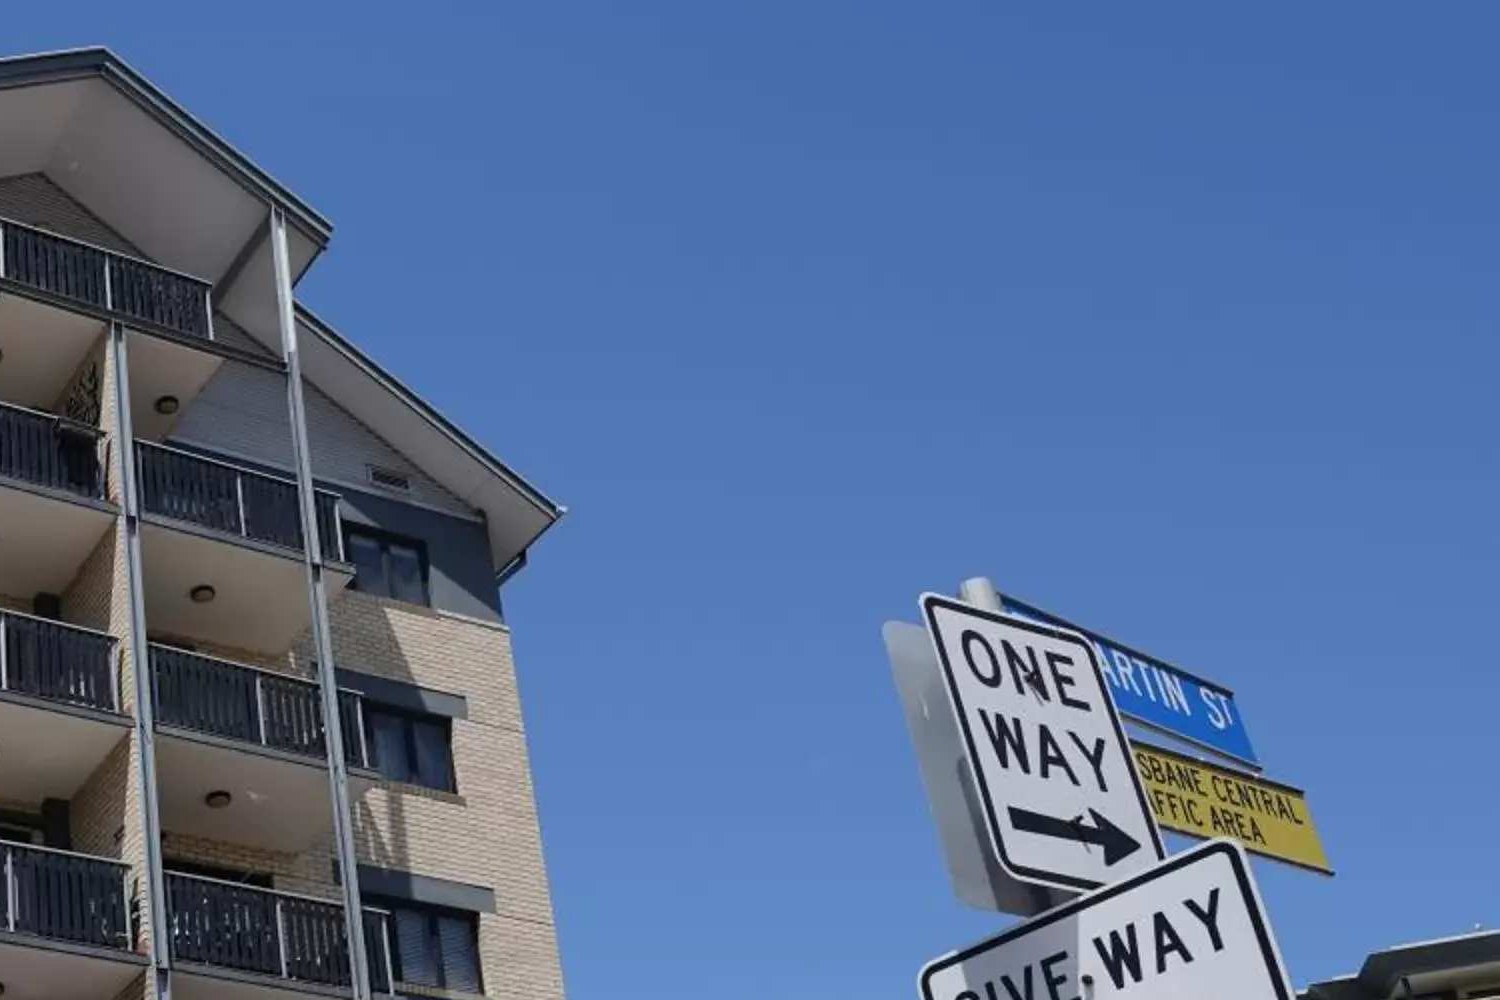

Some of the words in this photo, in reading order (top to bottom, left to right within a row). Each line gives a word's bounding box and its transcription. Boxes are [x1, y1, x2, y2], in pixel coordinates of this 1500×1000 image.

[961, 629, 1092, 712] ONE
[1094, 641, 1191, 716] ARTIN
[1200, 686, 1235, 730] ST
[978, 708, 1108, 793] WAY
[1136, 752, 1208, 796] SBANE
[1212, 776, 1303, 826] CENTRAL
[1210, 811, 1267, 846] AREA
[1093, 887, 1225, 989] WAY
